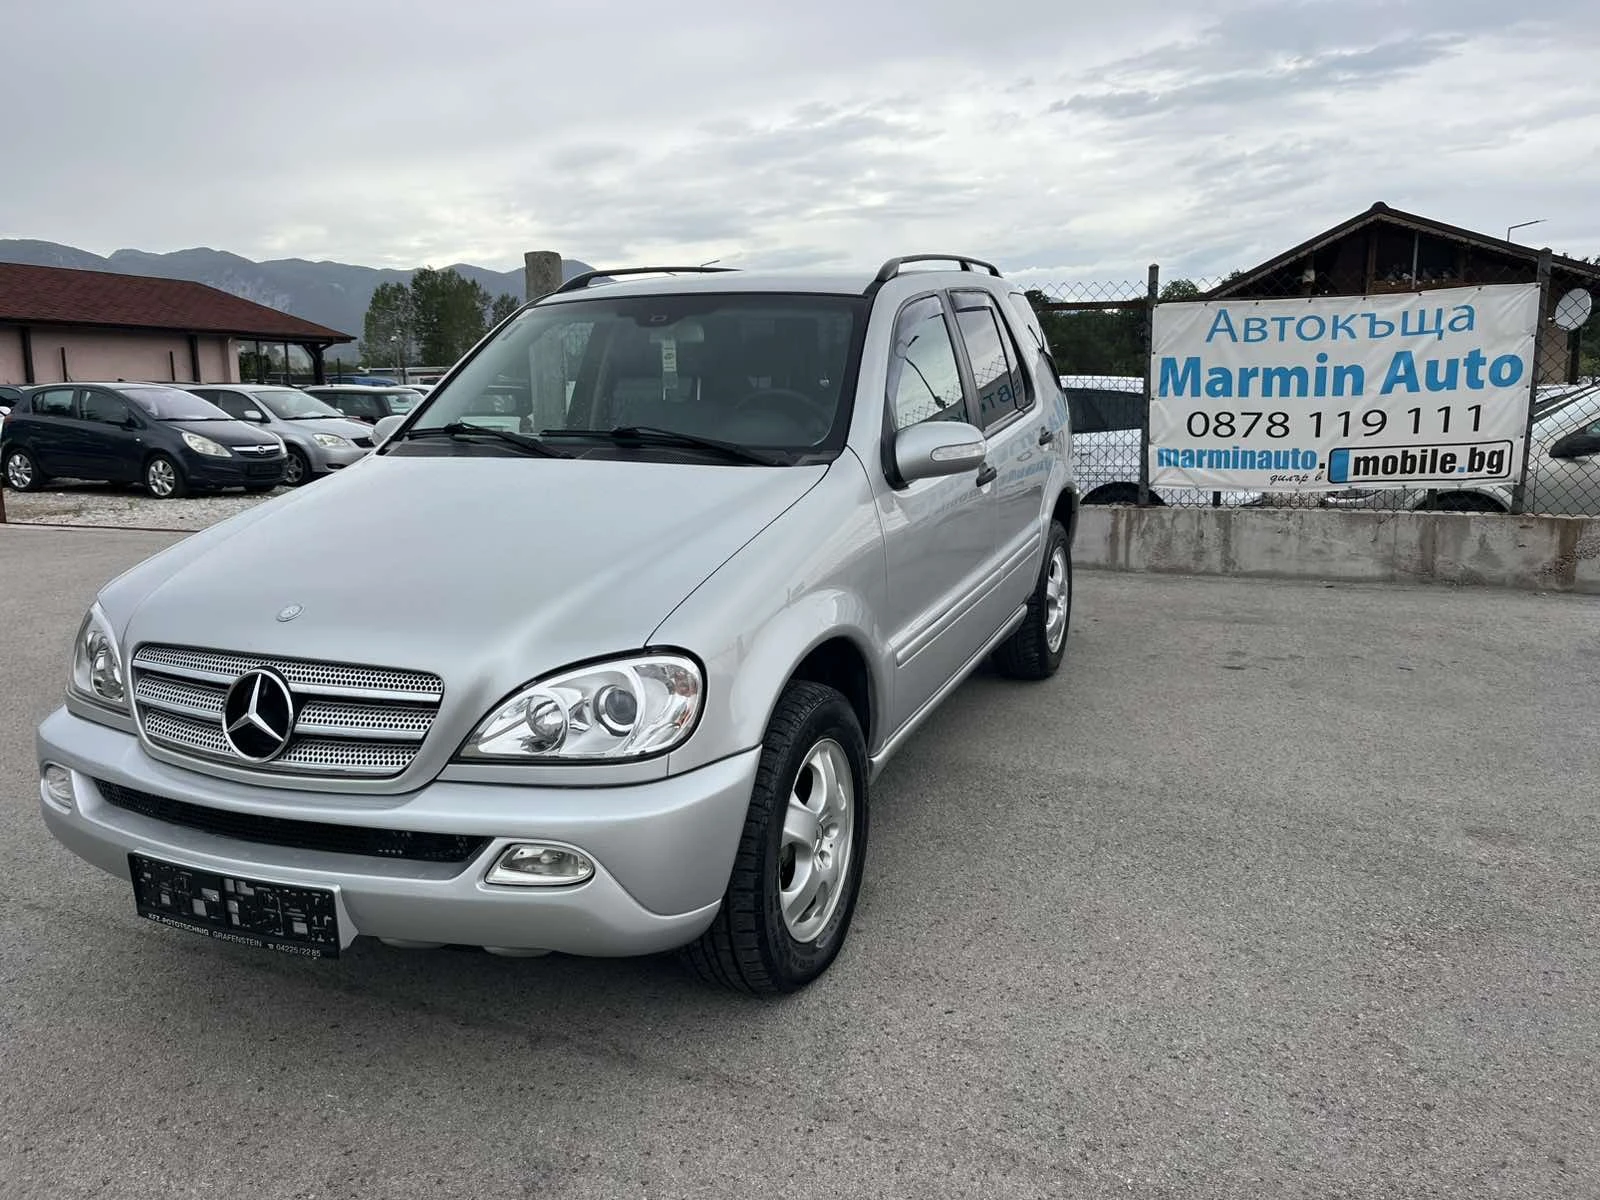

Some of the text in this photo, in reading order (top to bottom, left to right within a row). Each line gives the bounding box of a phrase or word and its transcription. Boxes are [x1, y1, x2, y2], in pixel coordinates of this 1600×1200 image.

[1205, 303, 1476, 343] Автокъща
[1159, 348, 1523, 398] Marmin Auto
[1186, 404, 1482, 439] 0878 119 111
[1352, 447, 1505, 475] mobile.bg
